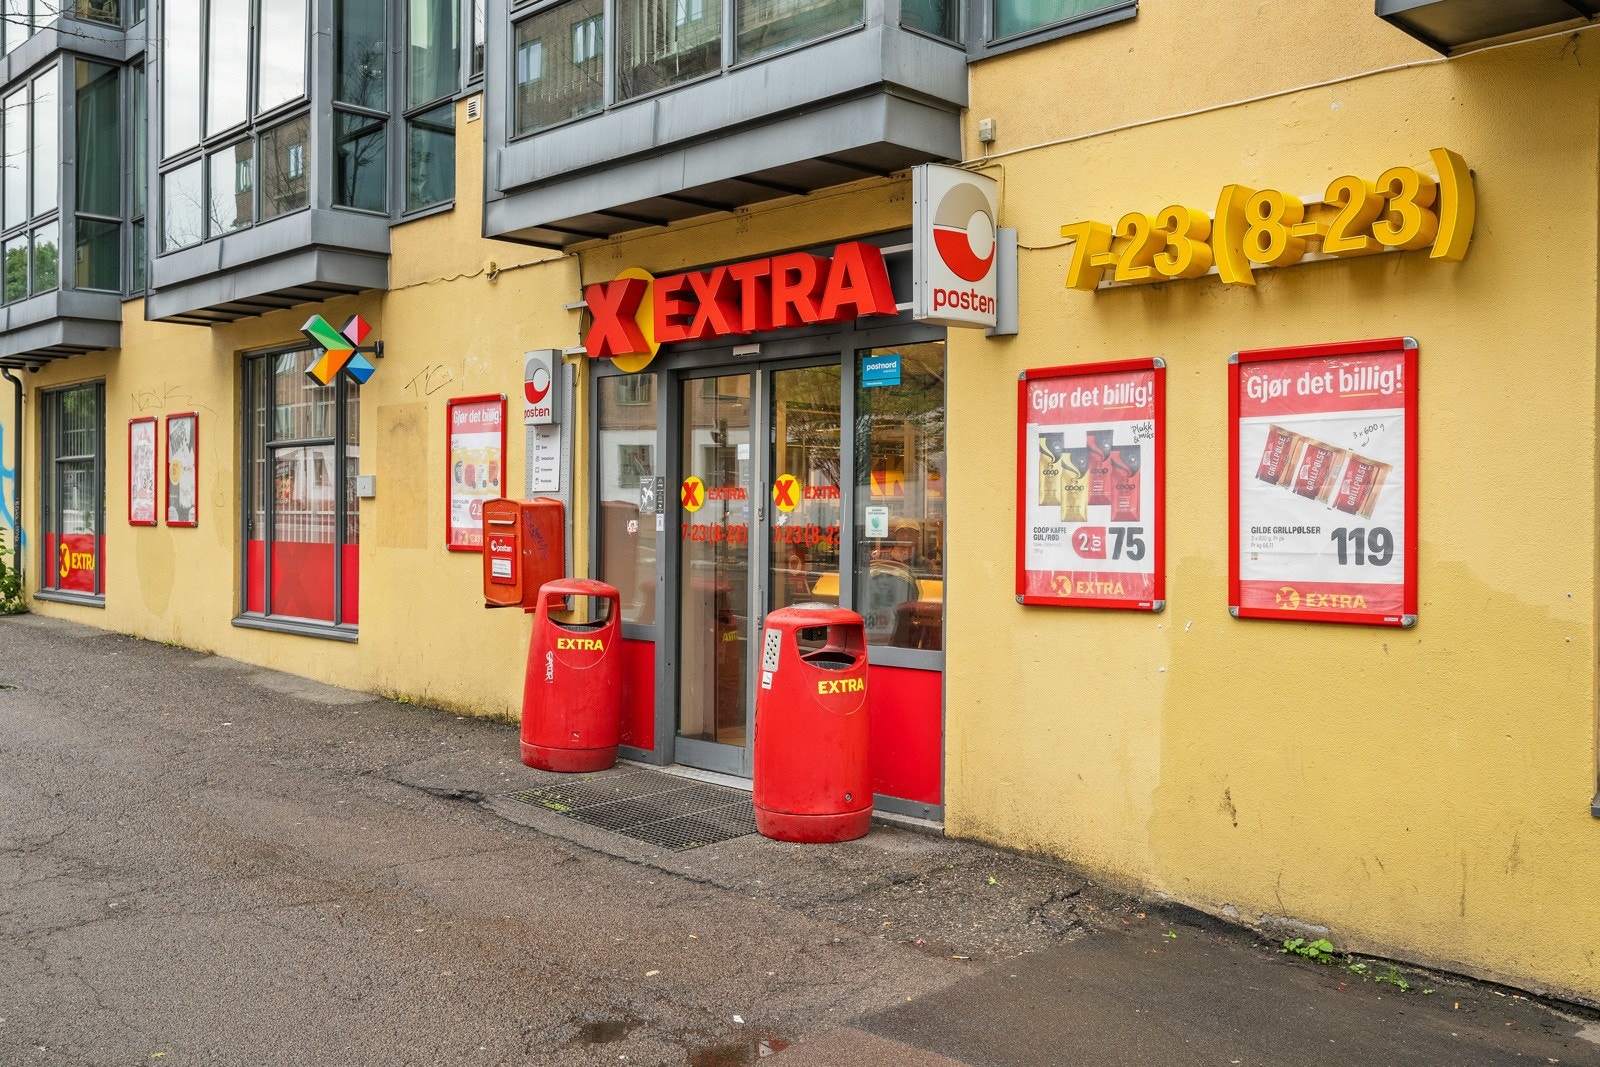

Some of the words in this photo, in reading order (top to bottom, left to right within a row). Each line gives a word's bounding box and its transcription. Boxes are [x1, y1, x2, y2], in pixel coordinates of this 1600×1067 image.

[652, 241, 898, 343] EXTRA
[933, 288, 995, 315] posten
[866, 361, 897, 372] postnord
[1247, 374, 1291, 403] Gjør
[1296, 371, 1333, 395] det
[1339, 364, 1402, 395] billig!
[1032, 388, 1067, 414] Gjør
[1070, 386, 1099, 408] det
[1103, 381, 1153, 408] billig!
[469, 409, 481, 423] det
[707, 486, 746, 500] EXTRA
[804, 485, 840, 500] EXTR
[1033, 526, 1050, 534] COOP
[1050, 526, 1067, 534] KAFFE
[1250, 526, 1272, 534] GILDE
[1272, 526, 1321, 534] GRILLPØLSER
[1032, 534, 1060, 542] GUL/RØD
[1078, 532, 1089, 552] 2
[1090, 534, 1102, 552] for
[1108, 526, 1146, 561] 75
[1330, 526, 1394, 566] 119
[1076, 581, 1124, 595] EXTRA
[1306, 593, 1368, 609] EXTRA
[558, 638, 604, 652] EXTRA
[818, 678, 864, 694] EXTRA
